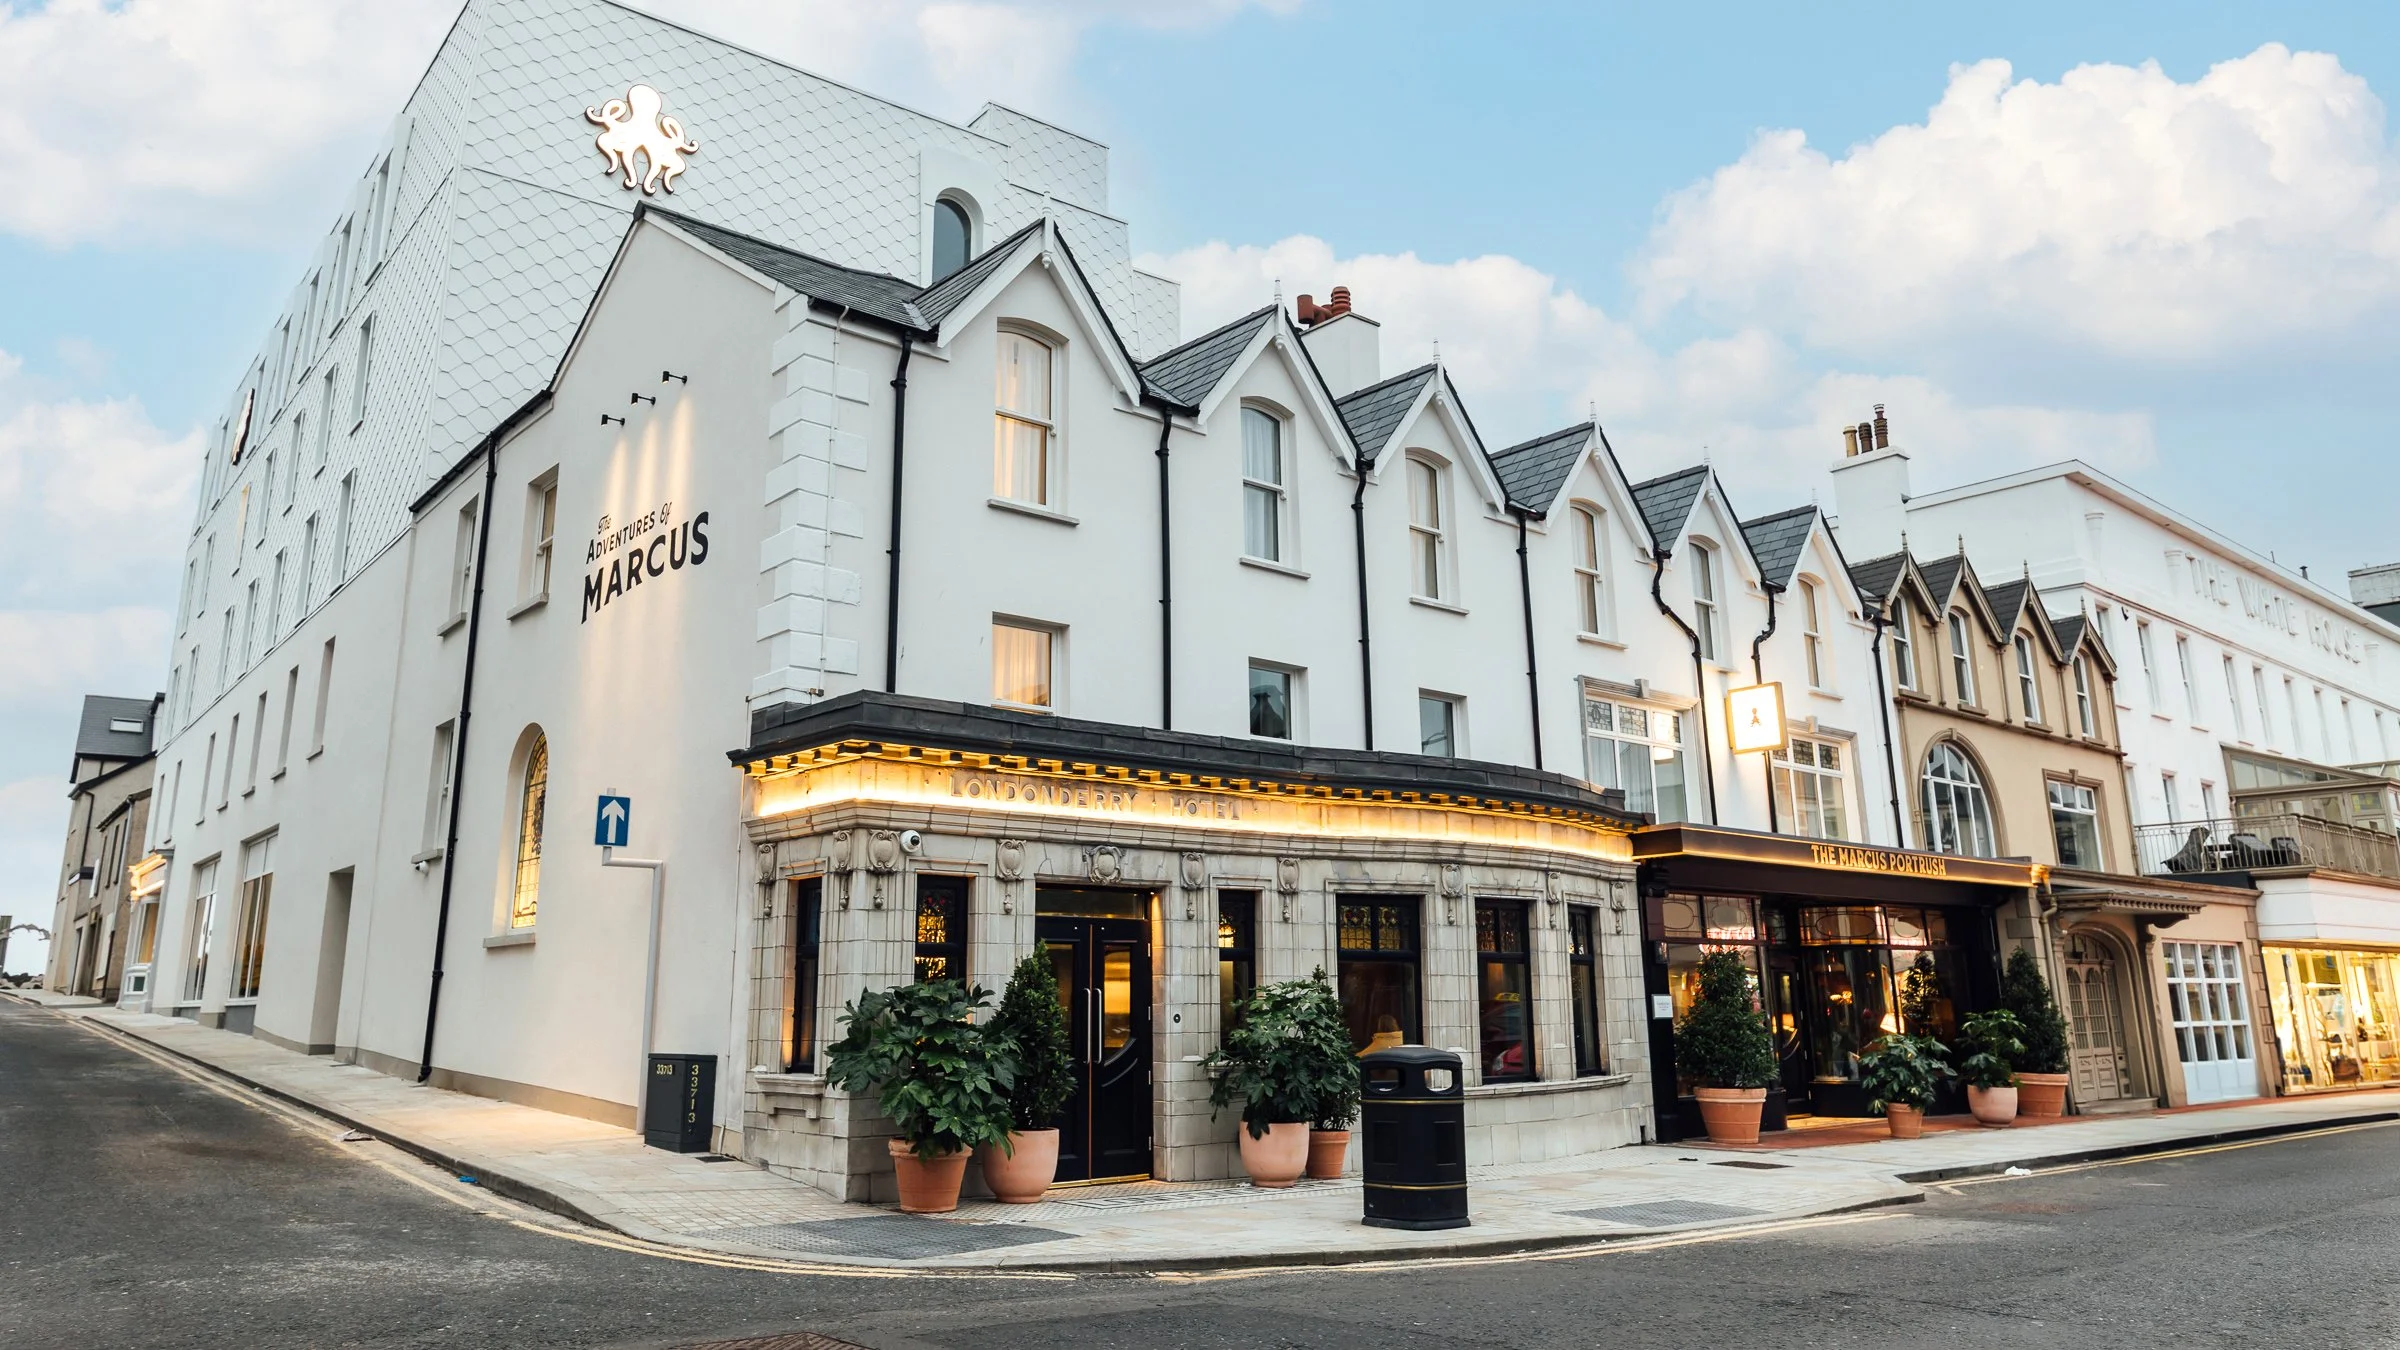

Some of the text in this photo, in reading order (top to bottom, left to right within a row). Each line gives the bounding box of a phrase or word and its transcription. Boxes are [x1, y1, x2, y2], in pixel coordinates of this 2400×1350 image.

[597, 514, 612, 535] The
[659, 501, 672, 525] Of
[581, 511, 709, 624] MARCUS
[949, 774, 1240, 821] LONDONDERRY HOTEL
[1811, 844, 1947, 876] THE MARCUS PORTRUSH
[688, 1064, 699, 1123] 33713
